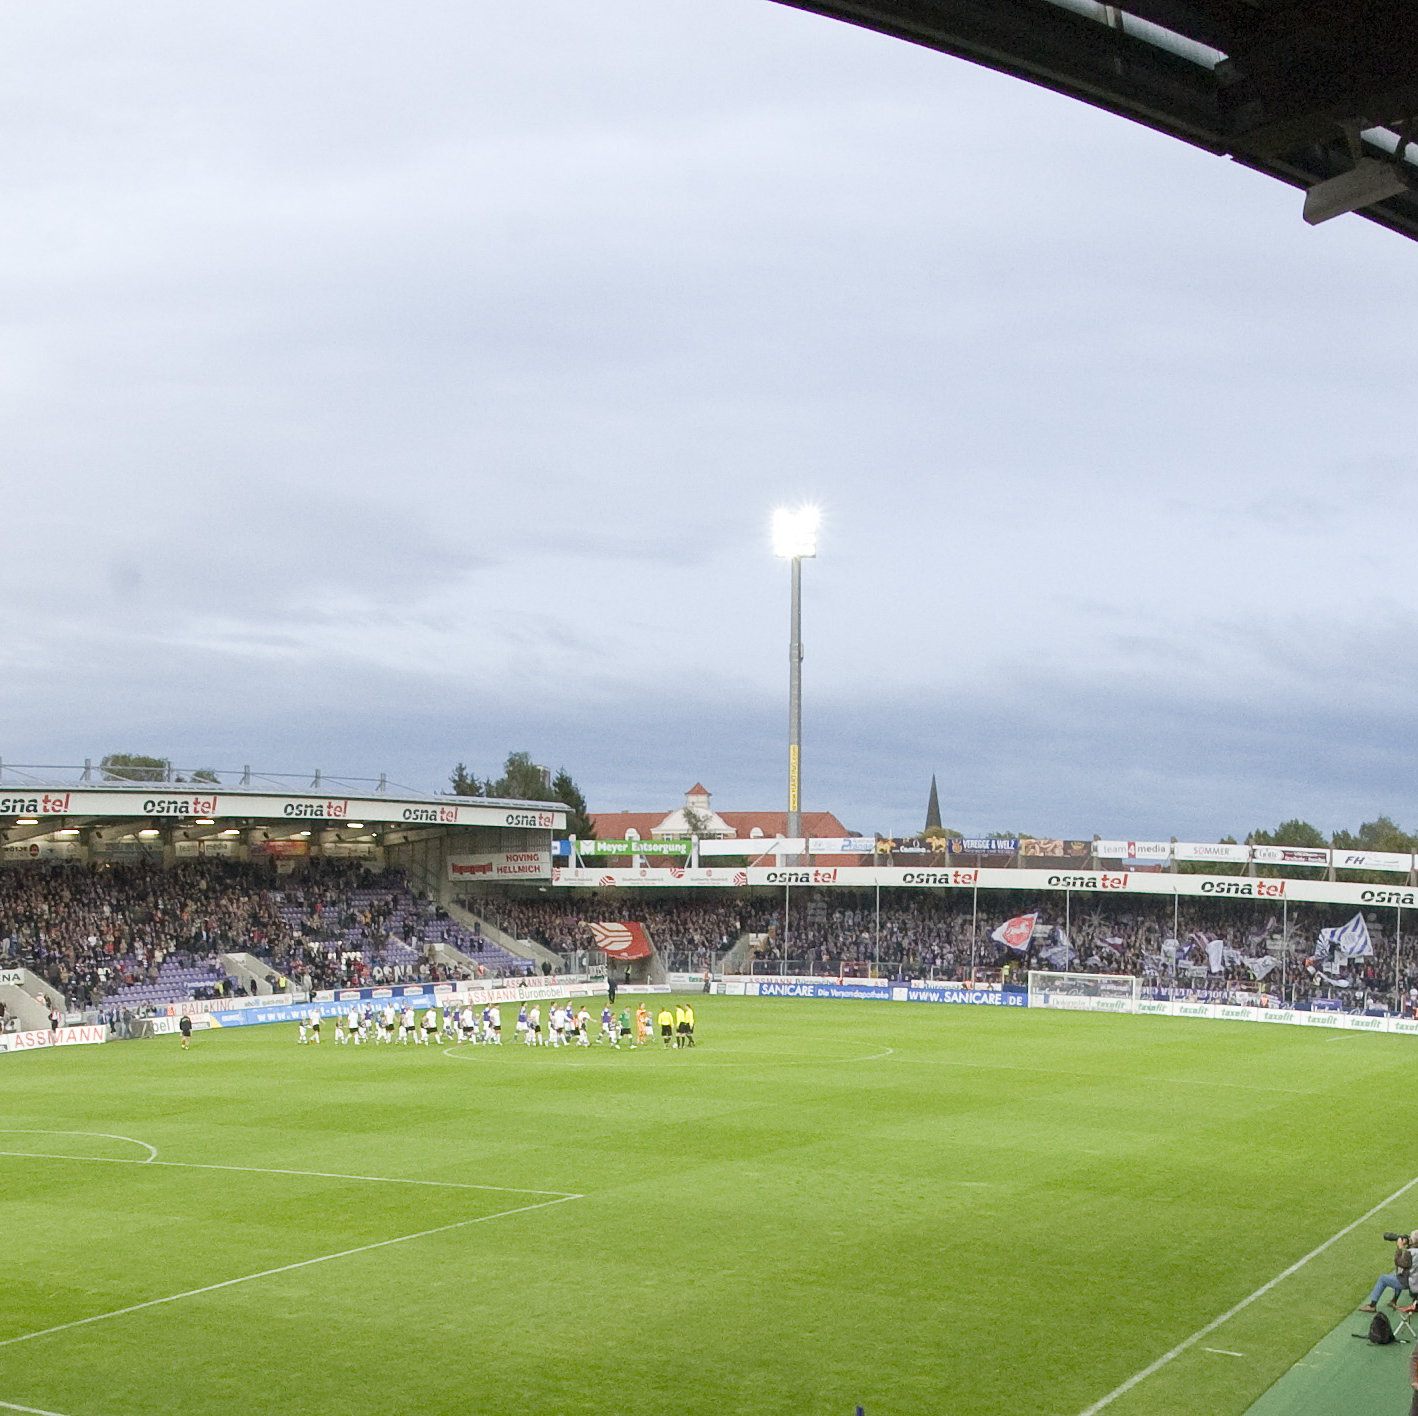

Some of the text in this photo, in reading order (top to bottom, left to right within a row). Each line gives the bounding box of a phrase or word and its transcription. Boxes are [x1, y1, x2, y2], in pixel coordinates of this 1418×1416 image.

[597, 841, 688, 855] Meyer Entsorgung
[1137, 844, 1166, 854] media
[506, 853, 539, 863] NOVING
[1345, 855, 1365, 865] FH
[497, 864, 541, 875] HELLMICH
[467, 987, 517, 1003] ASSMANN
[518, 984, 564, 999] Büromöbel
[761, 983, 815, 997] SANICARE
[817, 987, 889, 1001] Die Versandapotheke
